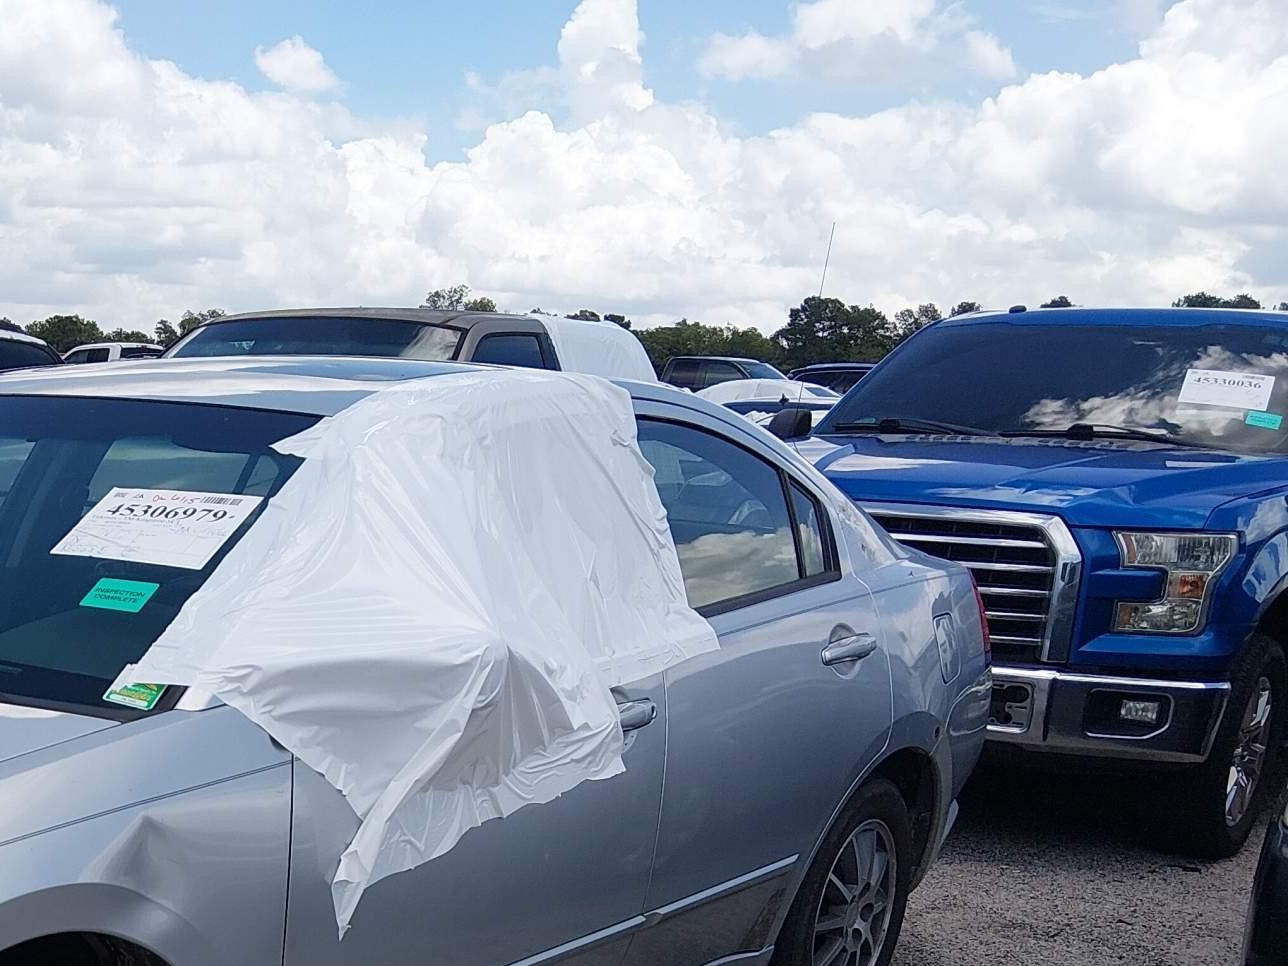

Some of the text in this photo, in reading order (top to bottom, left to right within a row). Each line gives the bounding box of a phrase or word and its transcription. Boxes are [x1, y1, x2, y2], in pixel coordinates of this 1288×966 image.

[1193, 376, 1262, 390] 45330036
[107, 503, 228, 523] 45306979
[93, 593, 140, 604] COMPLETE
[95, 587, 146, 598] INSPECTION
